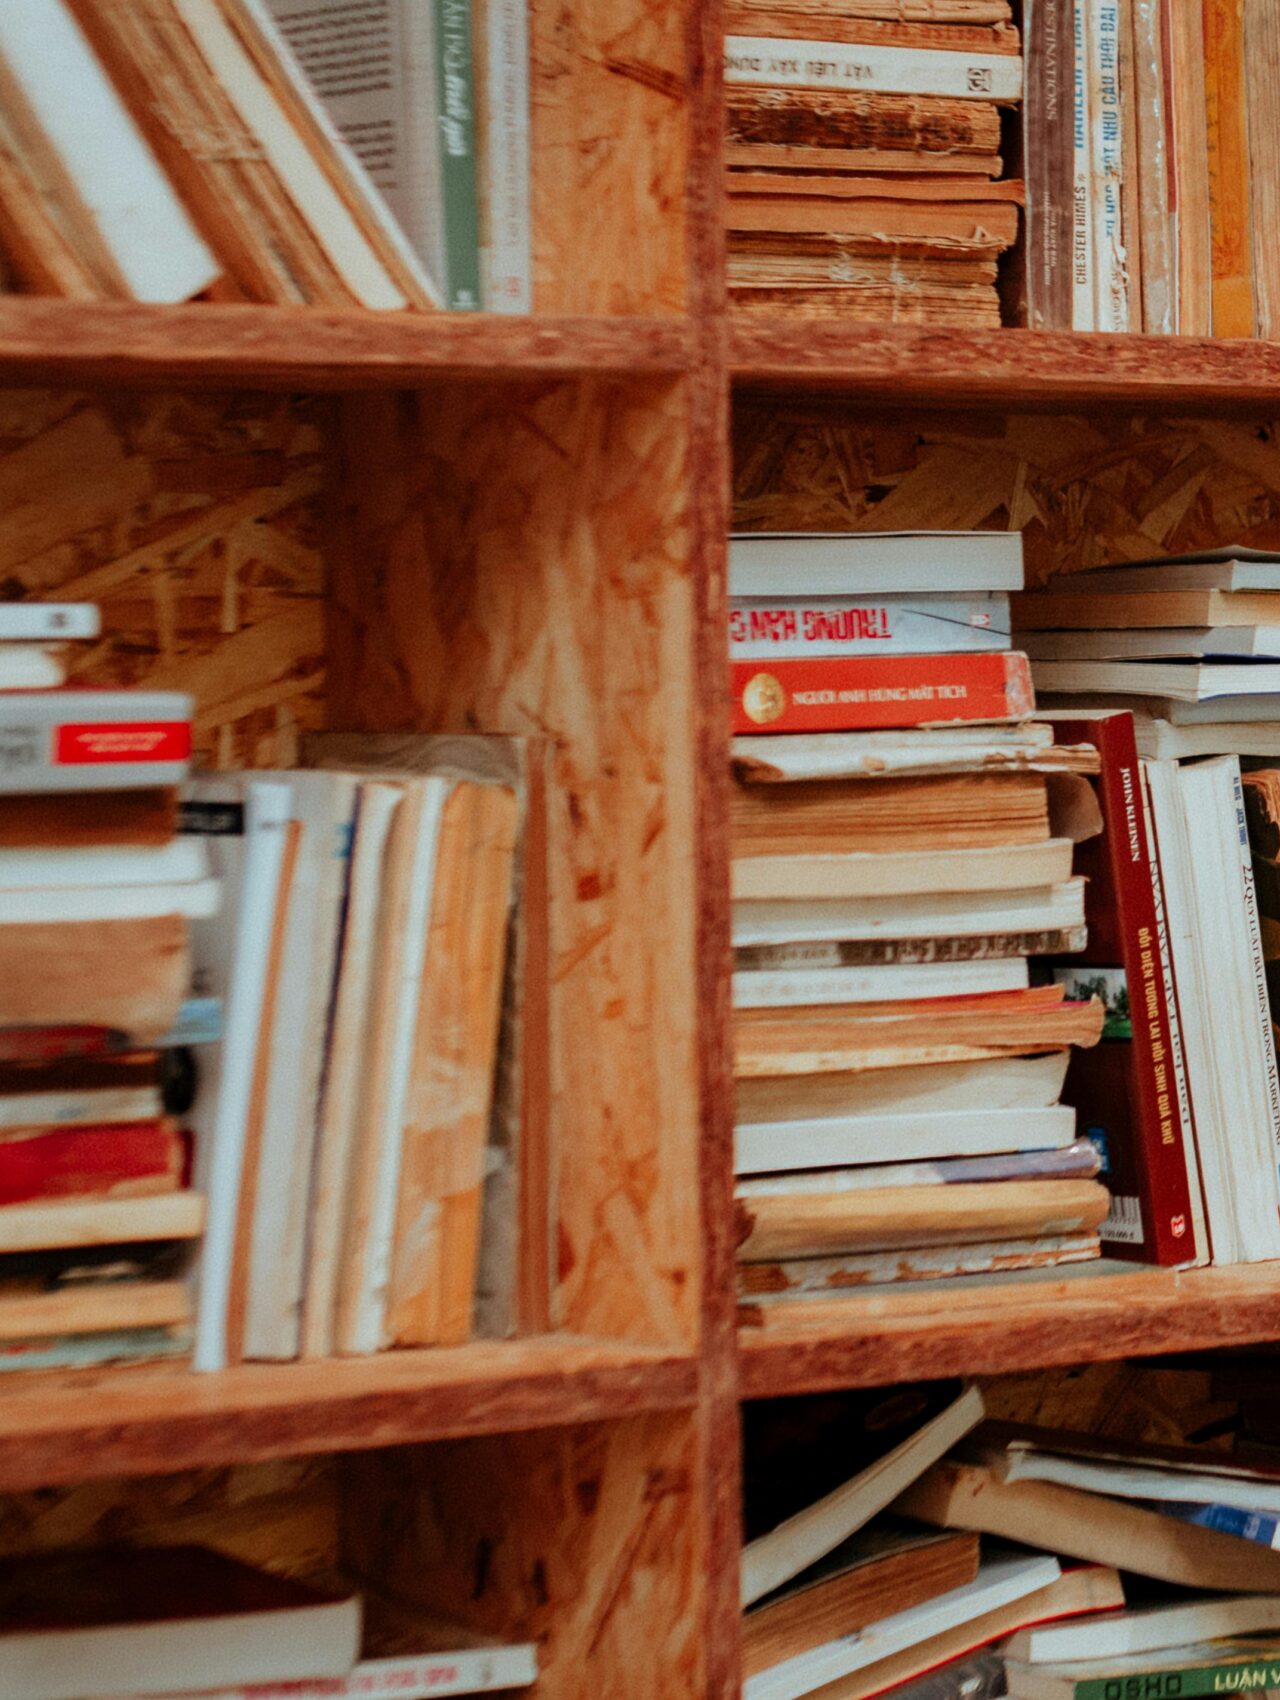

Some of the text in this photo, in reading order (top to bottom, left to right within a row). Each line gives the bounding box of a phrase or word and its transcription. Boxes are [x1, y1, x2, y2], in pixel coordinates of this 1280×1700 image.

[1074, 186, 1087, 285] CHESTER HIMES
[1120, 767, 1141, 862] JOHN KLEINEN
[1242, 864, 1254, 886] 22
[1244, 886, 1257, 917] QUY
[1138, 927, 1154, 949] ĐỐI
[1140, 951, 1157, 979] DIỆN
[1149, 1022, 1161, 1040] LAI
[1261, 1018, 1274, 1063] TRONG
[1150, 1042, 1167, 1063] HỒI
[1153, 1065, 1169, 1093] SINH
[1156, 1094, 1172, 1119] QUÁ
[1104, 1674, 1183, 1699] OSHO
[1214, 1666, 1267, 1692] LUẬN
